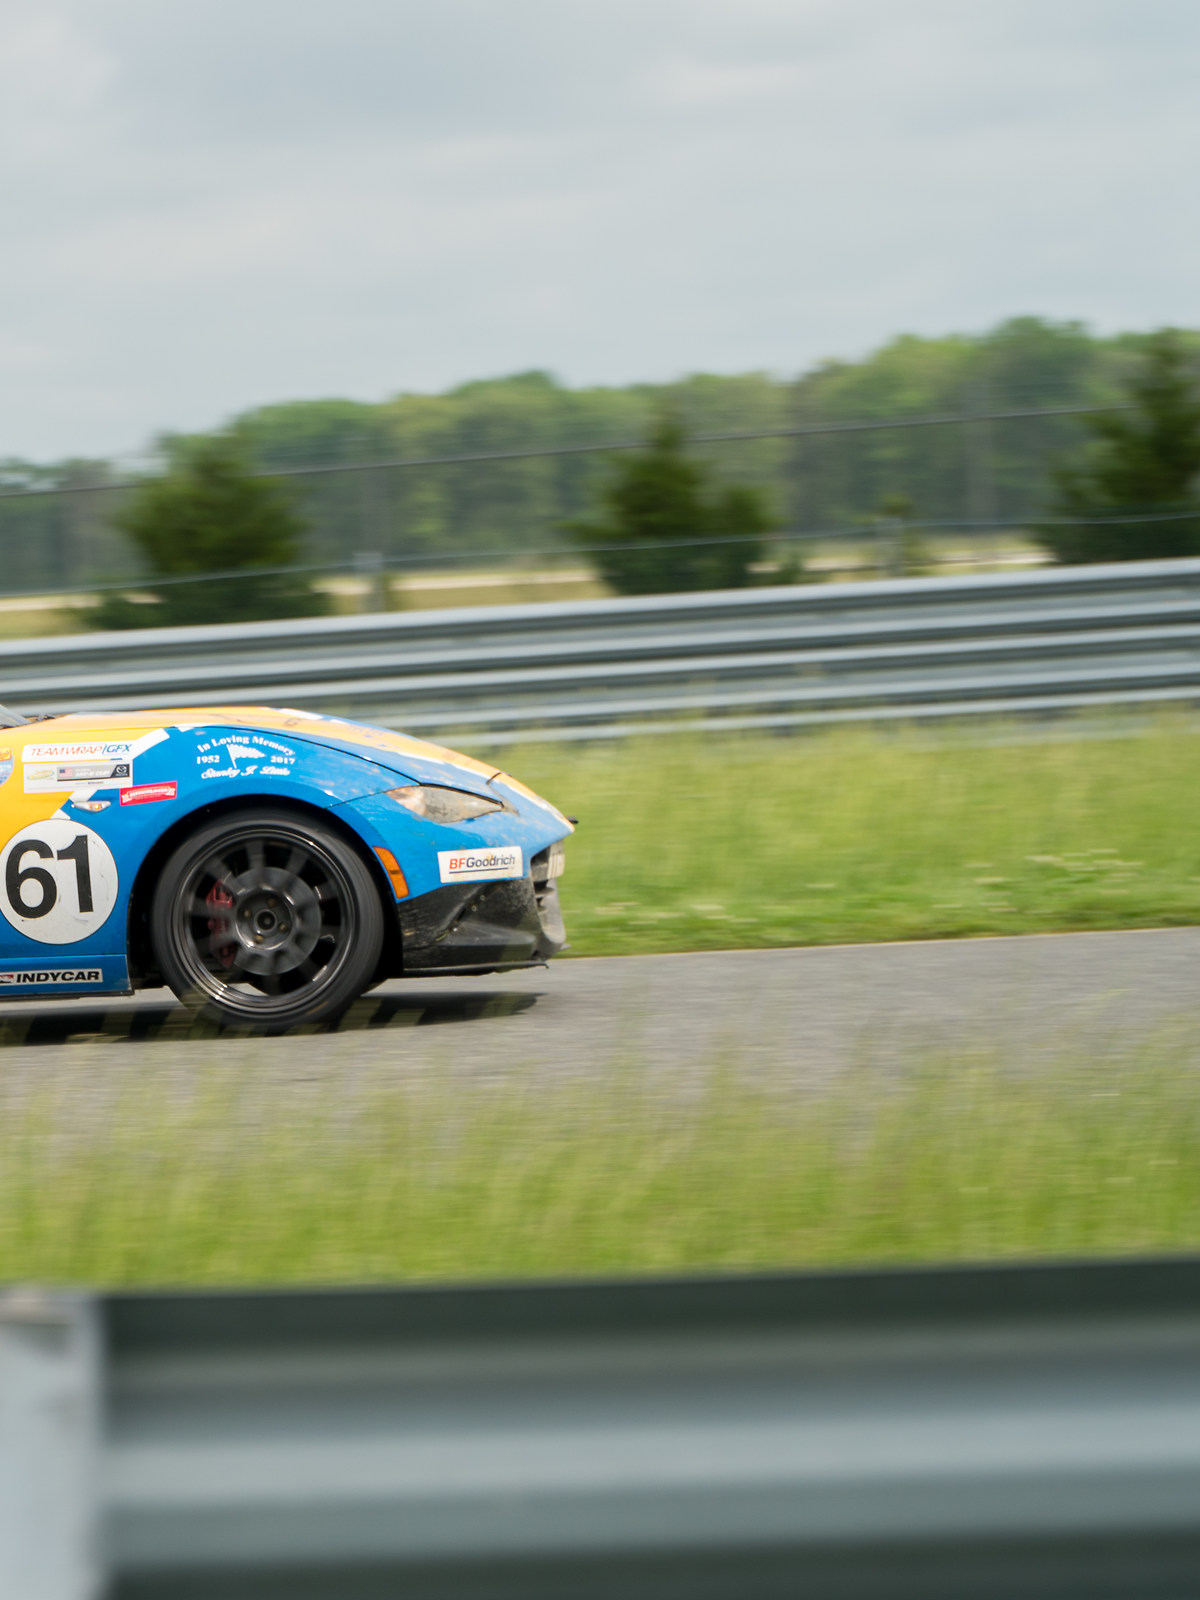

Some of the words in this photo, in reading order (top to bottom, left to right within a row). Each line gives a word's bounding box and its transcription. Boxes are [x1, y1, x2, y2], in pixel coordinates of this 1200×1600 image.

[197, 742, 211, 753] In
[211, 735, 250, 747] Loving
[252, 736, 296, 756] Memory
[196, 755, 220, 765] 1952
[270, 755, 296, 765] 2017
[449, 855, 515, 870] BFGoodrich
[5, 834, 94, 919] 61
[16, 971, 100, 983] INDYCAR
